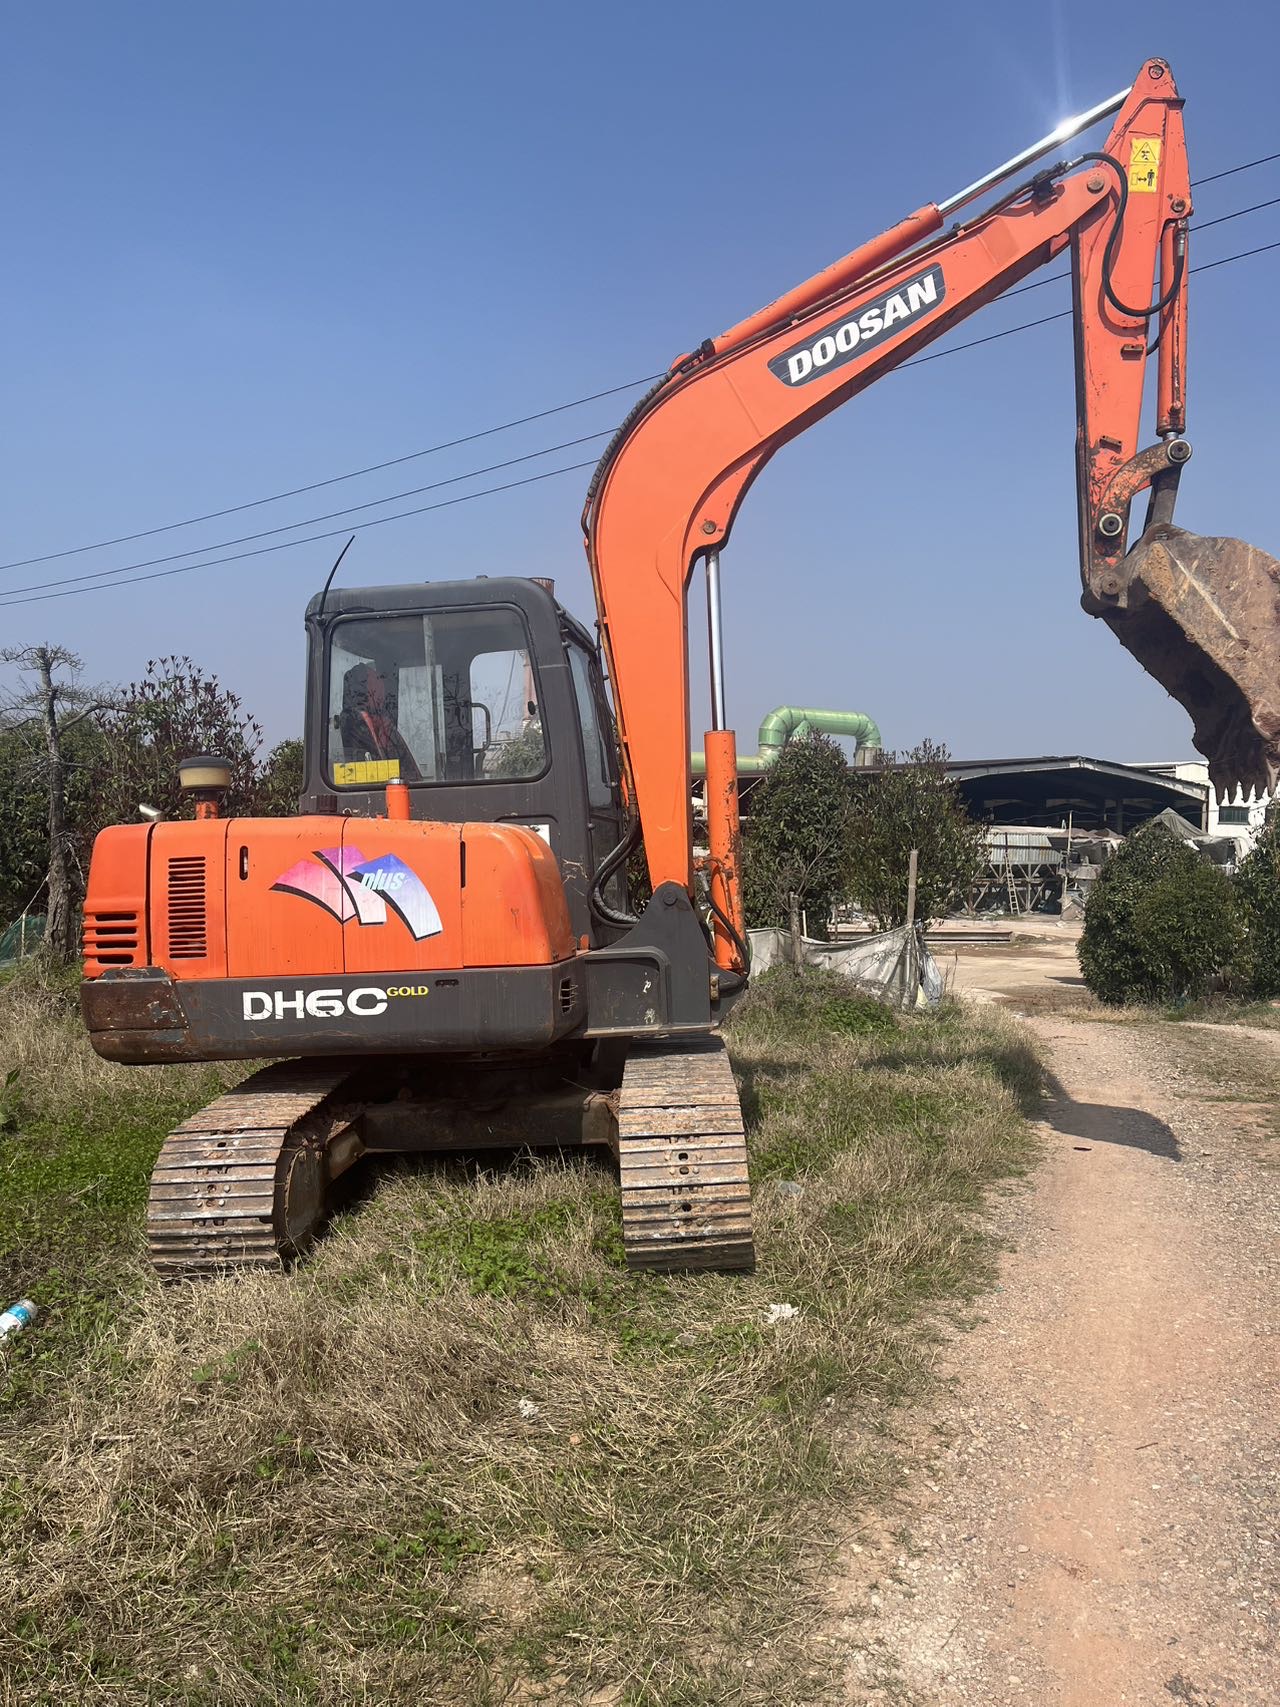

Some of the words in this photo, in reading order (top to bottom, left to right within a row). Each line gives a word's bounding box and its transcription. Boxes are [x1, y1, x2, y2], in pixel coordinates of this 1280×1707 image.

[787, 274, 938, 384] DOOSAN
[359, 868, 405, 893] plus
[386, 985, 429, 997] GOLD
